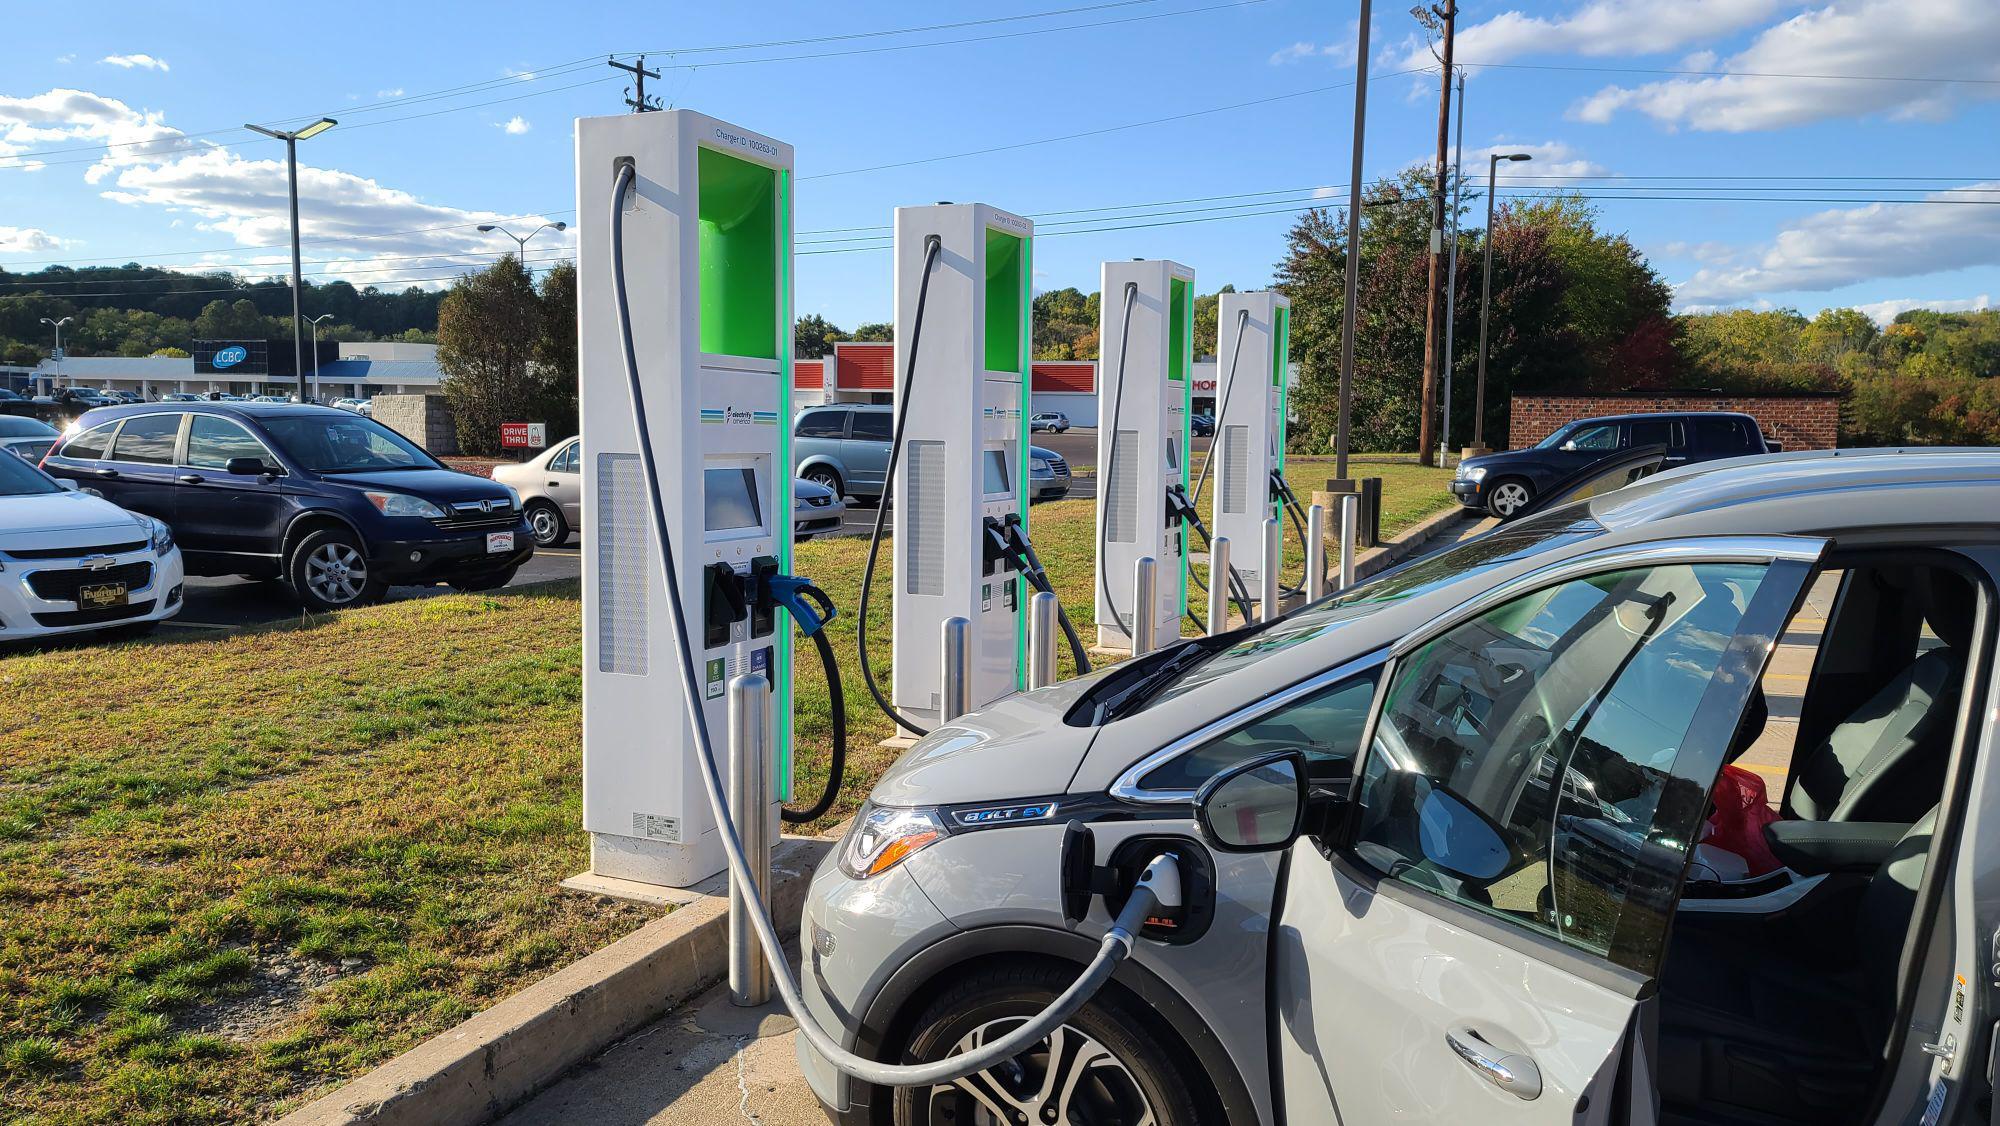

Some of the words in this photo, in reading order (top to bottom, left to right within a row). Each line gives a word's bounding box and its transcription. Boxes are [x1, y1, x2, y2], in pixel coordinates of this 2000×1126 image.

[715, 128, 739, 145] Charger
[739, 135, 747, 146] ID
[748, 139, 778, 157] 100263-01
[216, 351, 241, 363] LCBC
[503, 427, 528, 436] DRIVE
[505, 436, 527, 444] THRU
[964, 808, 1018, 822] BOLT
[1023, 805, 1050, 818] EV
